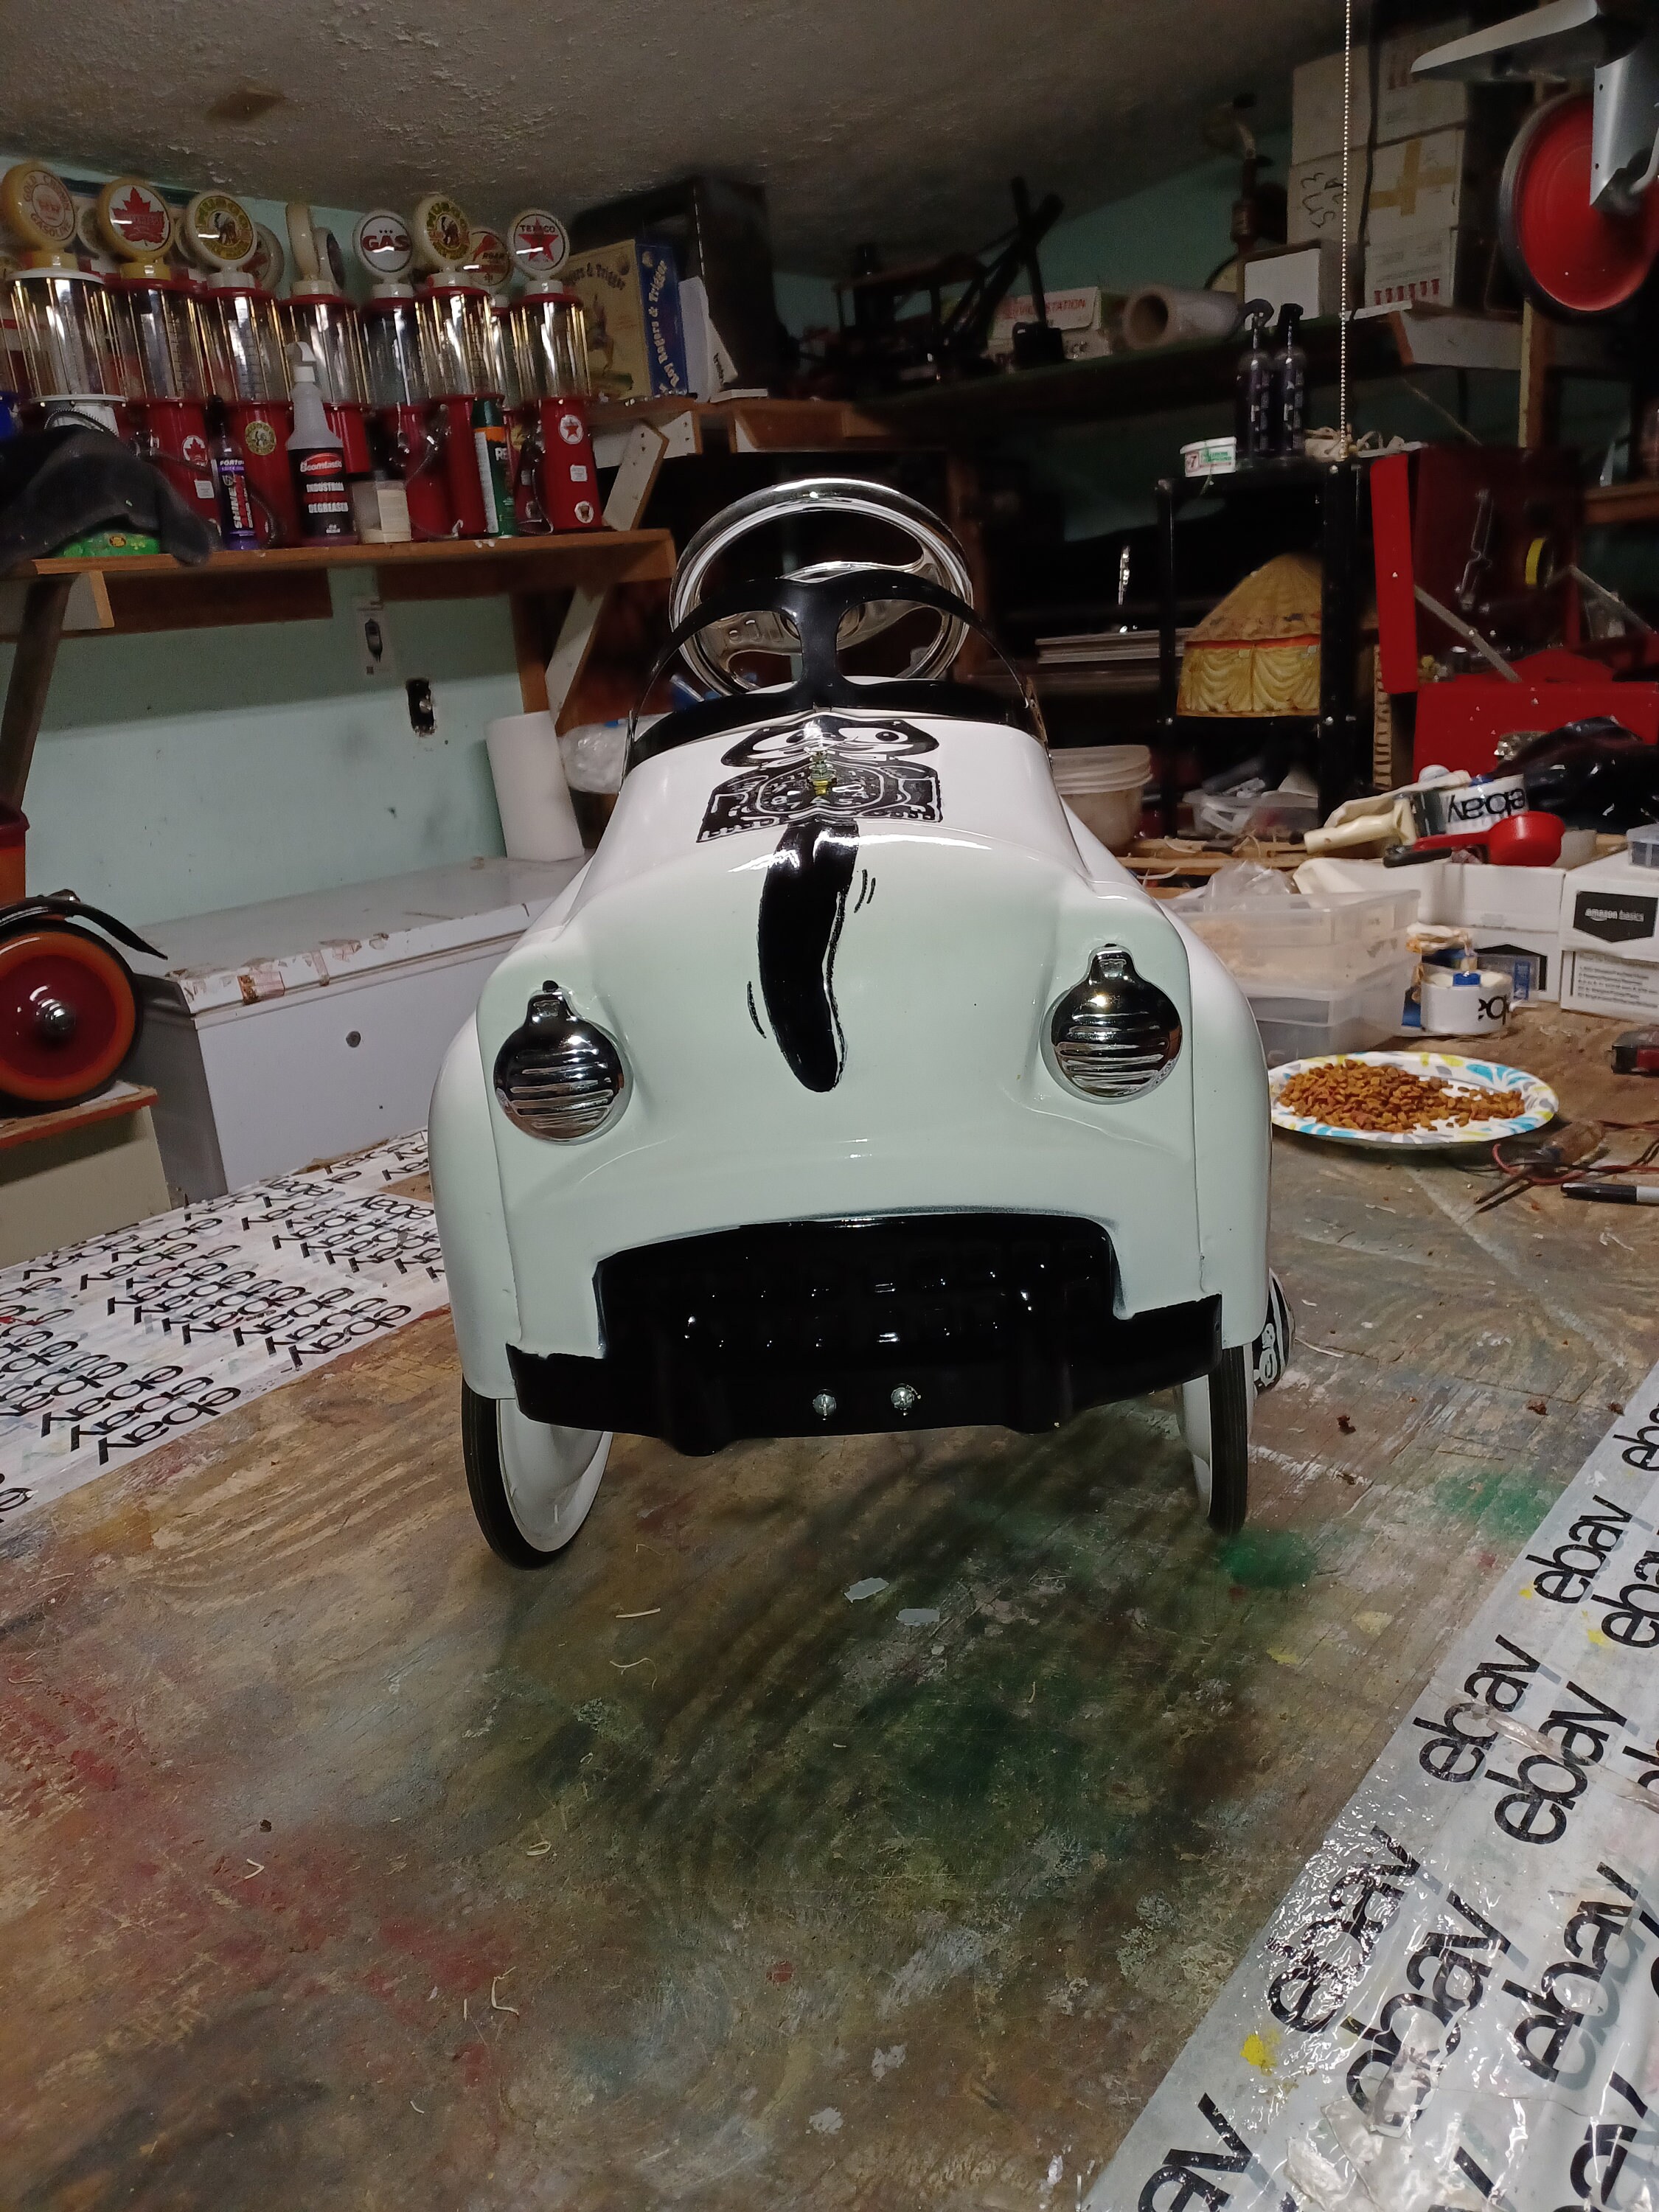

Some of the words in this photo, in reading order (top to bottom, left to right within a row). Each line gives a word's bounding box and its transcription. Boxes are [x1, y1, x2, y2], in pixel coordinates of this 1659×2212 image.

[362, 234, 410, 252] GAS
[1447, 787, 1526, 823] ebay
[79, 1242, 198, 1291] ebay
[107, 1262, 229, 1317] ebay
[133, 1270, 257, 1326] ebay
[181, 1286, 307, 1346] ebay
[288, 1304, 411, 1367] ebay
[41, 1365, 184, 1439] ebay
[97, 1386, 242, 1467] ebay
[1525, 1494, 1634, 1605] ebay
[1412, 1633, 1543, 1784] ebay
[1484, 1680, 1628, 1846] ebay
[1265, 1824, 1421, 2034] ebay
